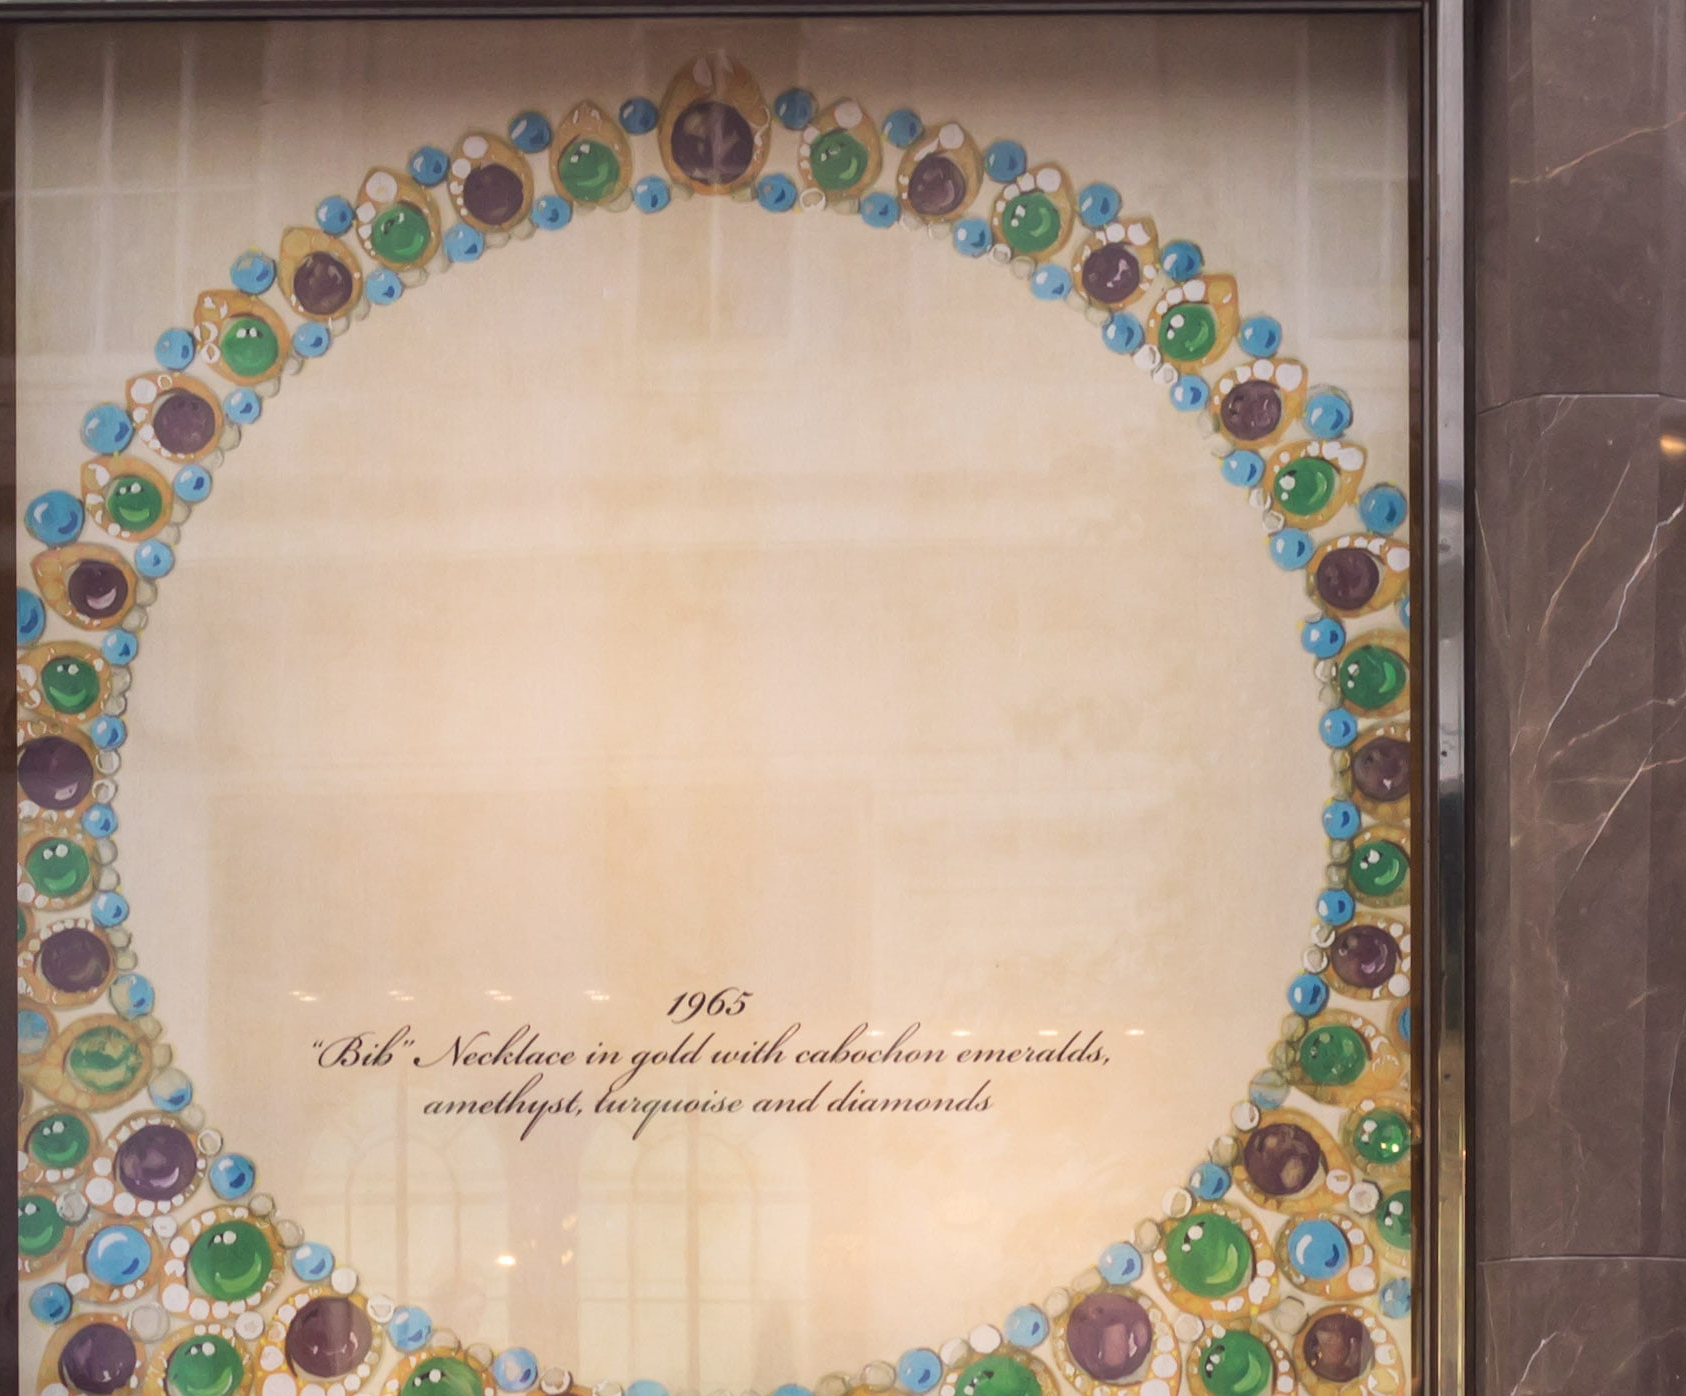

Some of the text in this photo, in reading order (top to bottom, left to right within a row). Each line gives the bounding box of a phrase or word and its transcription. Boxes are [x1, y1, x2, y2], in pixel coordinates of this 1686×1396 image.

[666, 987, 753, 1024] 1965
[413, 1024, 576, 1067] Necklace
[584, 1042, 620, 1066] in
[611, 1032, 716, 1093] gold
[711, 1023, 801, 1064] with
[795, 1022, 949, 1064] cabochon
[956, 1030, 1111, 1066] emeralds,
[423, 1073, 993, 1142] amethyst, turquoise and diamonds
